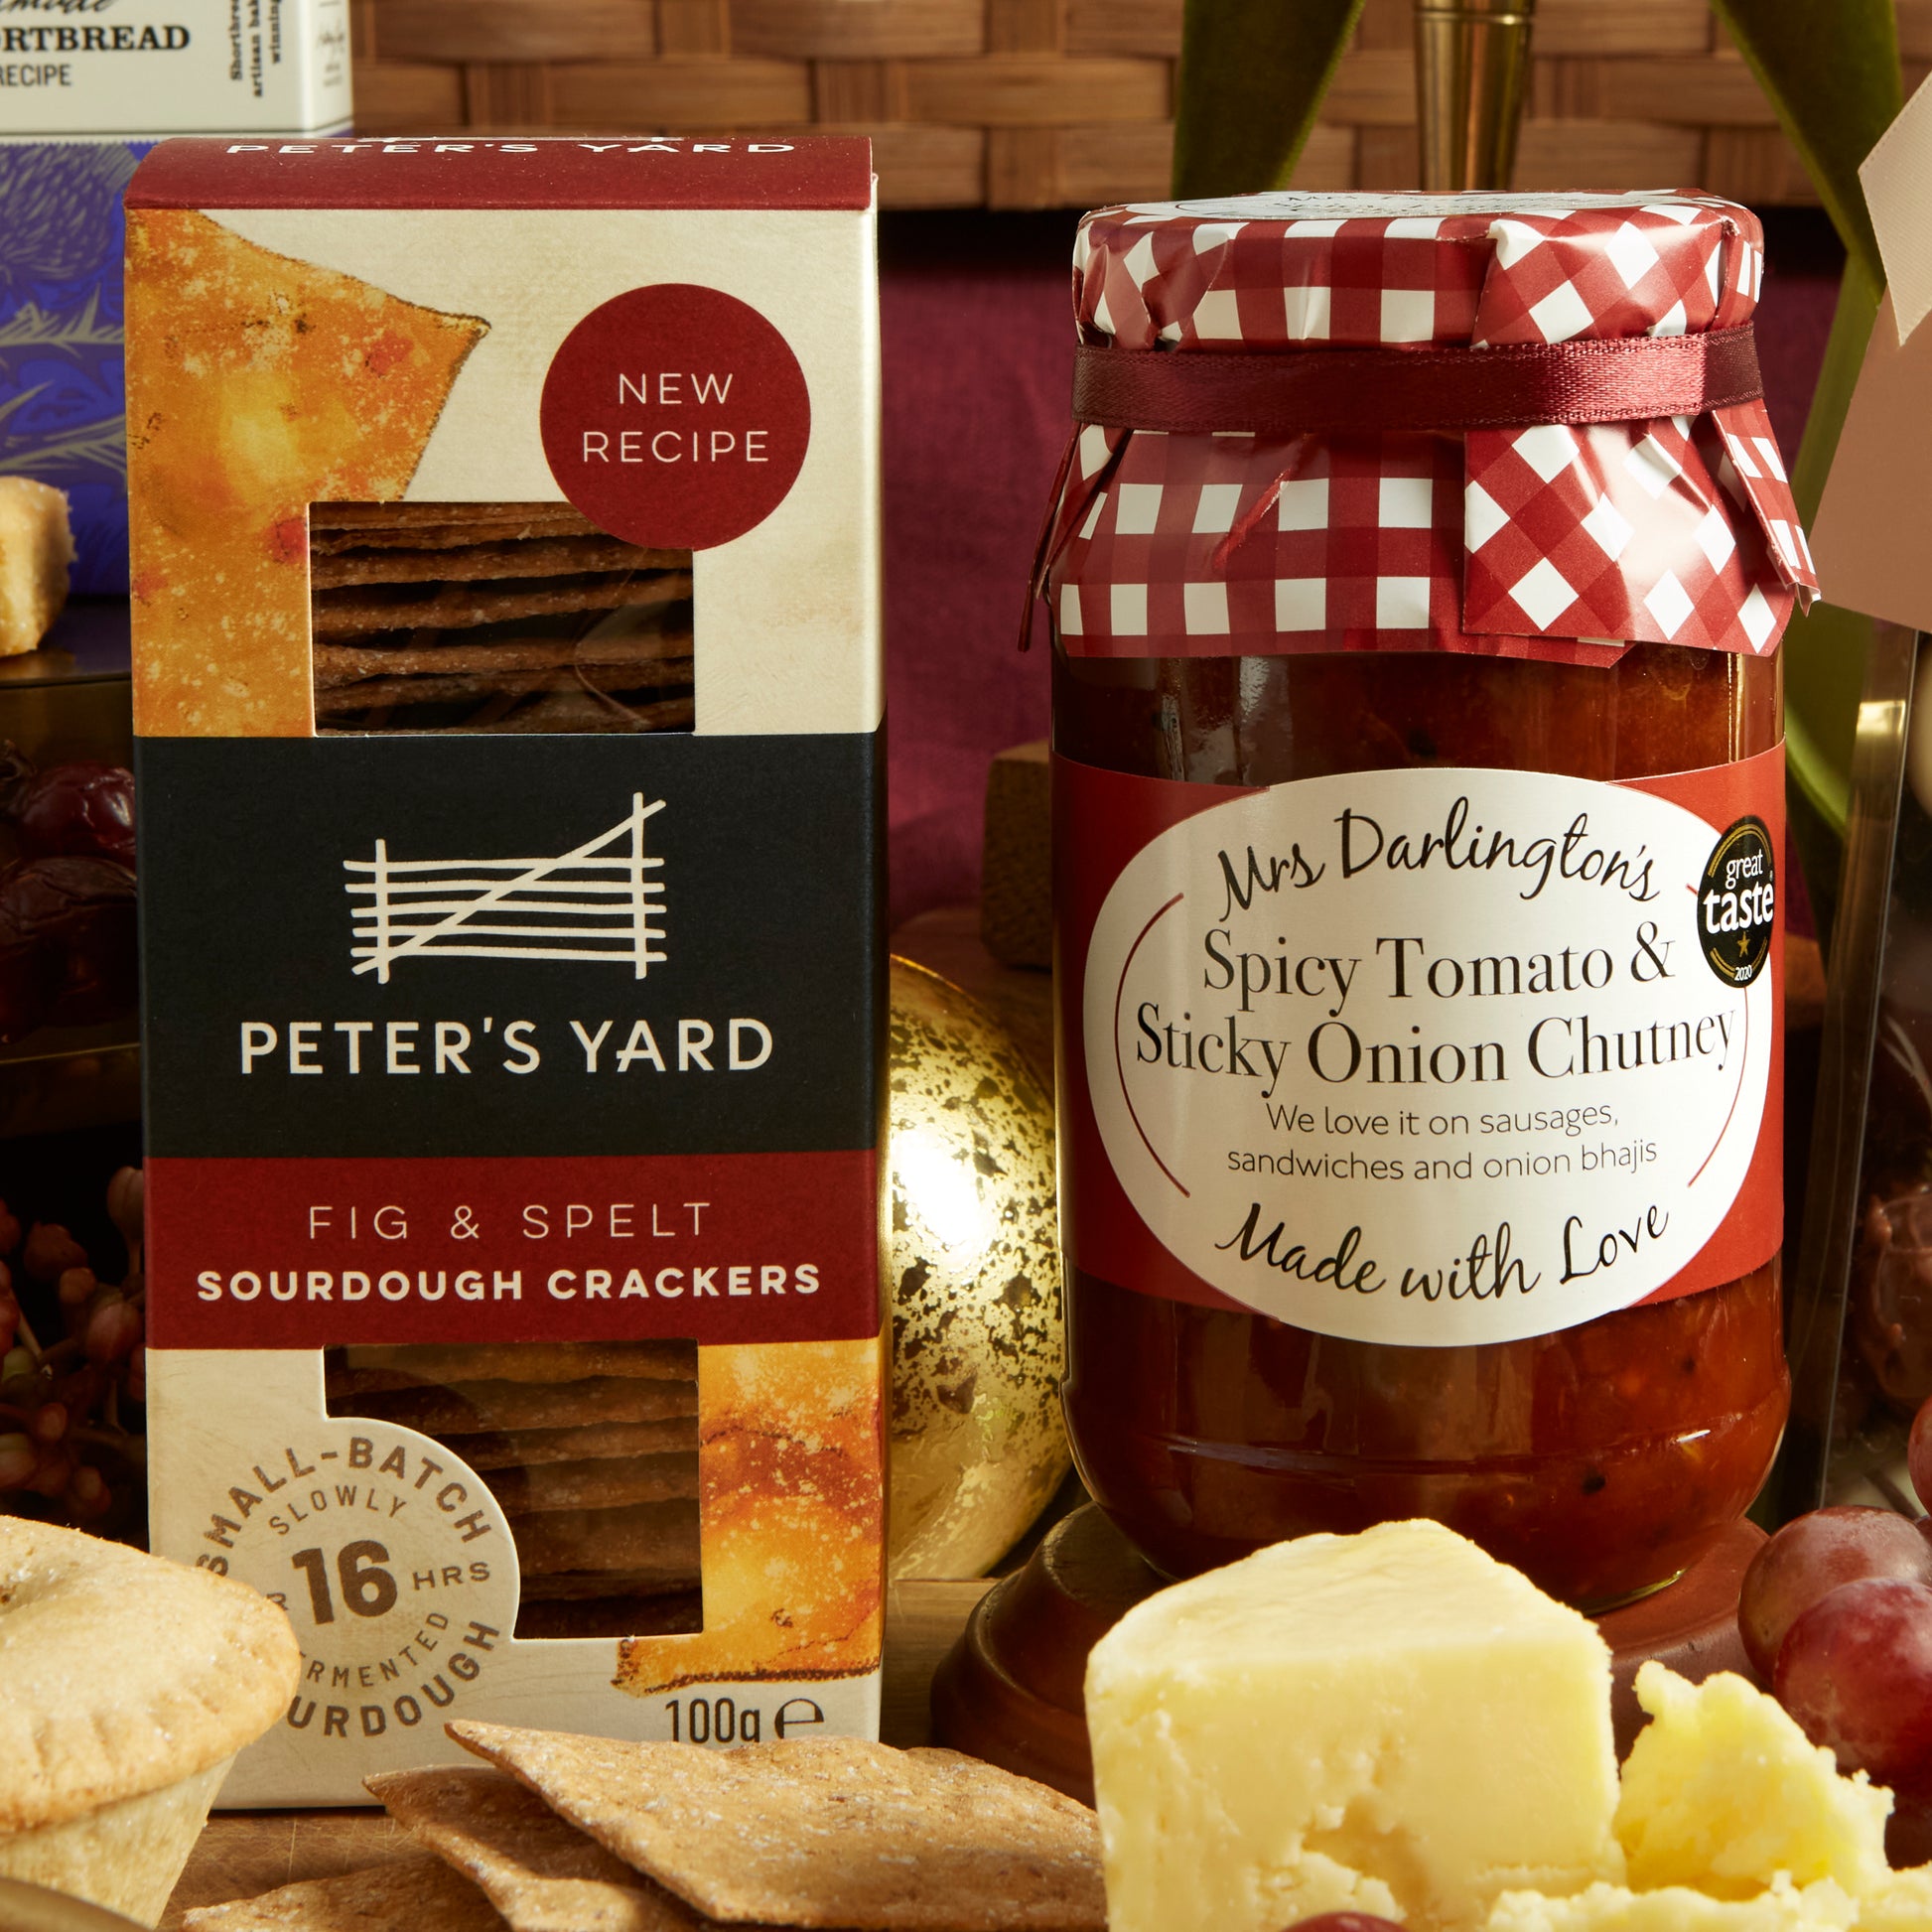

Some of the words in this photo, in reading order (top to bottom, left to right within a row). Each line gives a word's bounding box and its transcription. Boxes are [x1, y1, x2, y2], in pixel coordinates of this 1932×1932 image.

[0, 26, 191, 52] RTBREAD
[229, 0, 242, 80] Shortbre
[251, 35, 262, 97] artisan
[227, 144, 537, 153] PETER'S
[620, 373, 733, 404] NEW
[584, 431, 767, 462] RECIPE
[1218, 843, 1326, 922] Mrs
[1332, 795, 1661, 900] Darlington's
[1725, 848, 1763, 890] great
[1703, 881, 1774, 934] taste
[1203, 921, 1362, 1017] Spicy
[1375, 937, 1612, 998] Tomato
[1630, 920, 1676, 983] &
[1733, 964, 1753, 981] 2020
[241, 1018, 539, 1073] PETER'S
[570, 1019, 772, 1072] YARD
[1137, 1001, 1292, 1099] Sticky
[1308, 1022, 1508, 1083] Onion
[1527, 1008, 1736, 1080] Chutney
[1266, 1103, 1313, 1132] We
[1325, 1106, 1388, 1135] love
[1399, 1107, 1421, 1136] it
[1430, 1116, 1468, 1135] on
[1479, 1103, 1619, 1138] sausages,
[1228, 1150, 1403, 1179] sandwiches
[1414, 1153, 1471, 1179] and
[1483, 1155, 1570, 1177] onion
[1583, 1143, 1656, 1173] bhajis
[311, 1206, 406, 1239] FIG
[451, 1206, 479, 1239] &
[523, 1203, 709, 1238] SPELT
[1214, 1202, 1387, 1295] Made
[1401, 1222, 1541, 1302] with
[1559, 1203, 1670, 1285] Love
[198, 1271, 521, 1301] SOURDOUGH
[548, 1264, 819, 1299] CRACKERS
[269, 1485, 407, 1535] SLOWLY
[292, 1540, 397, 1624] 16
[413, 1562, 489, 1590] HRS
[299, 1611, 449, 1689] RMENTED
[287, 1620, 500, 1738] URDOUGH
